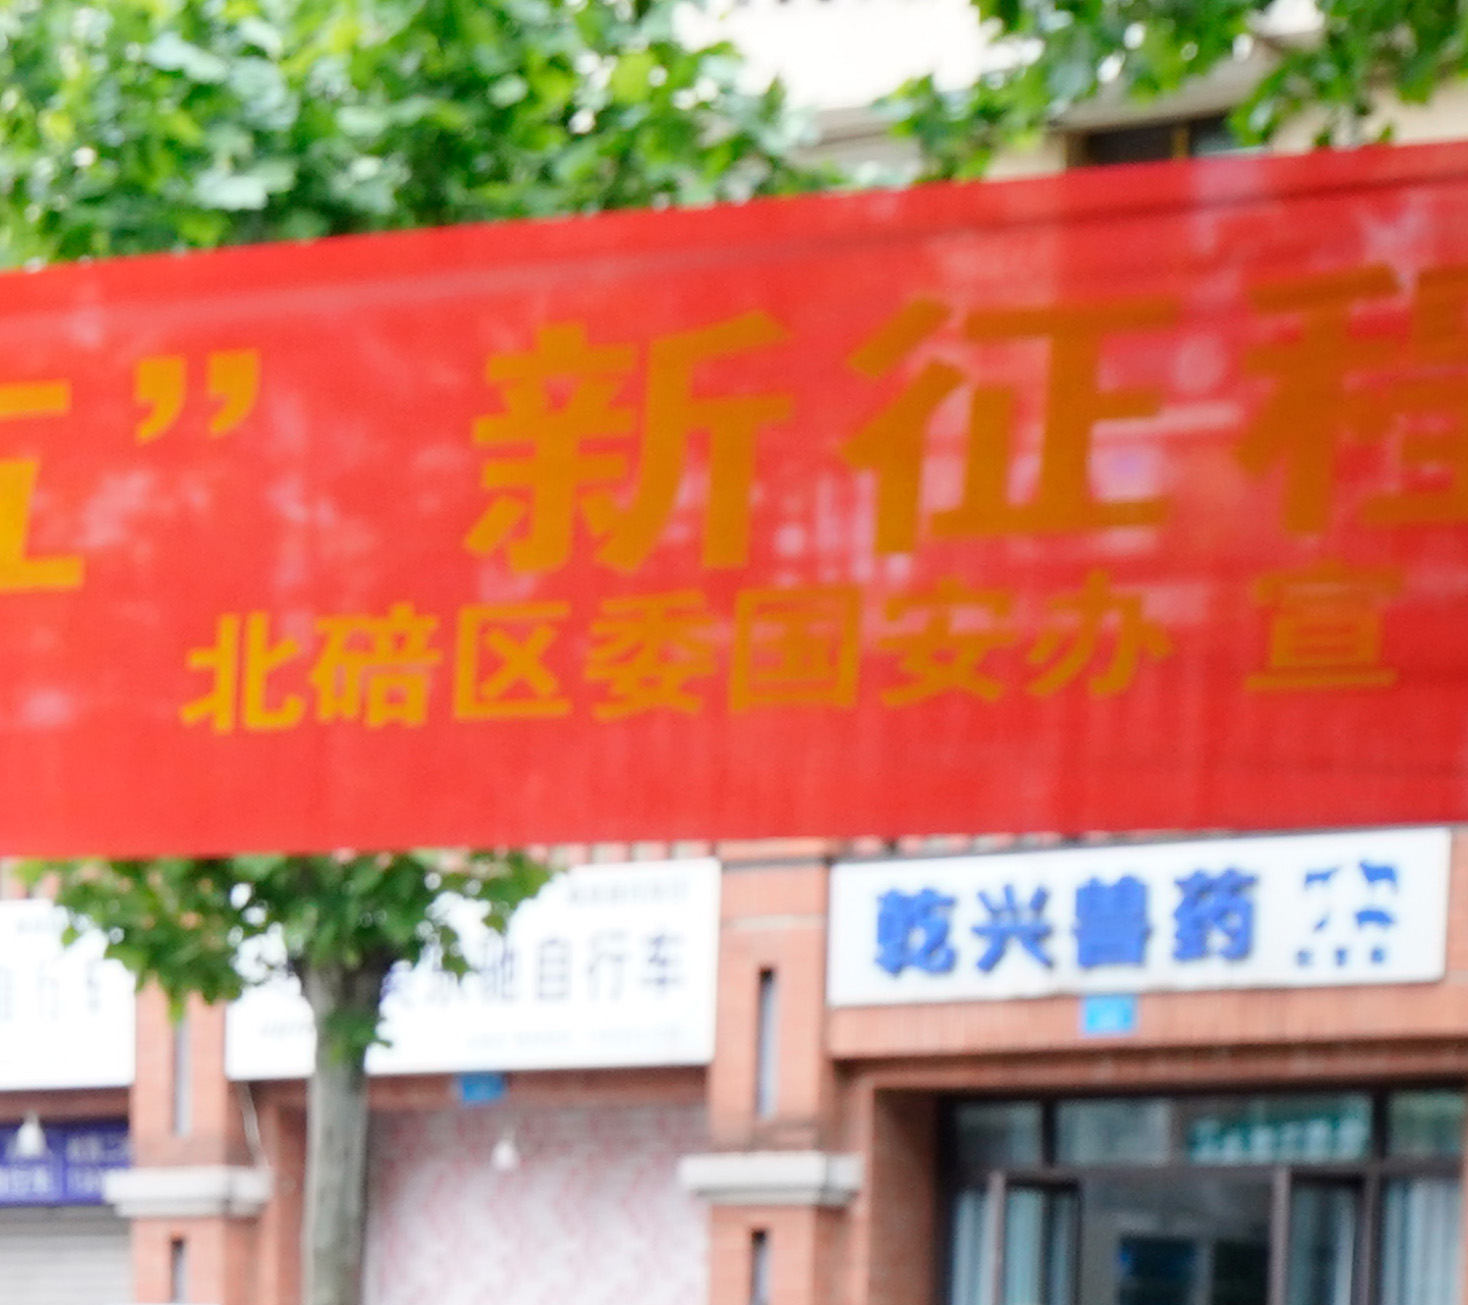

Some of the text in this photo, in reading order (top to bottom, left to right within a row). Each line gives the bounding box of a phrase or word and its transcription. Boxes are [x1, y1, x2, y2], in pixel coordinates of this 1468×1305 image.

[181, 558, 1400, 734] 北碚区委国安办 宣
[873, 866, 1259, 977] 乾兴兽药
